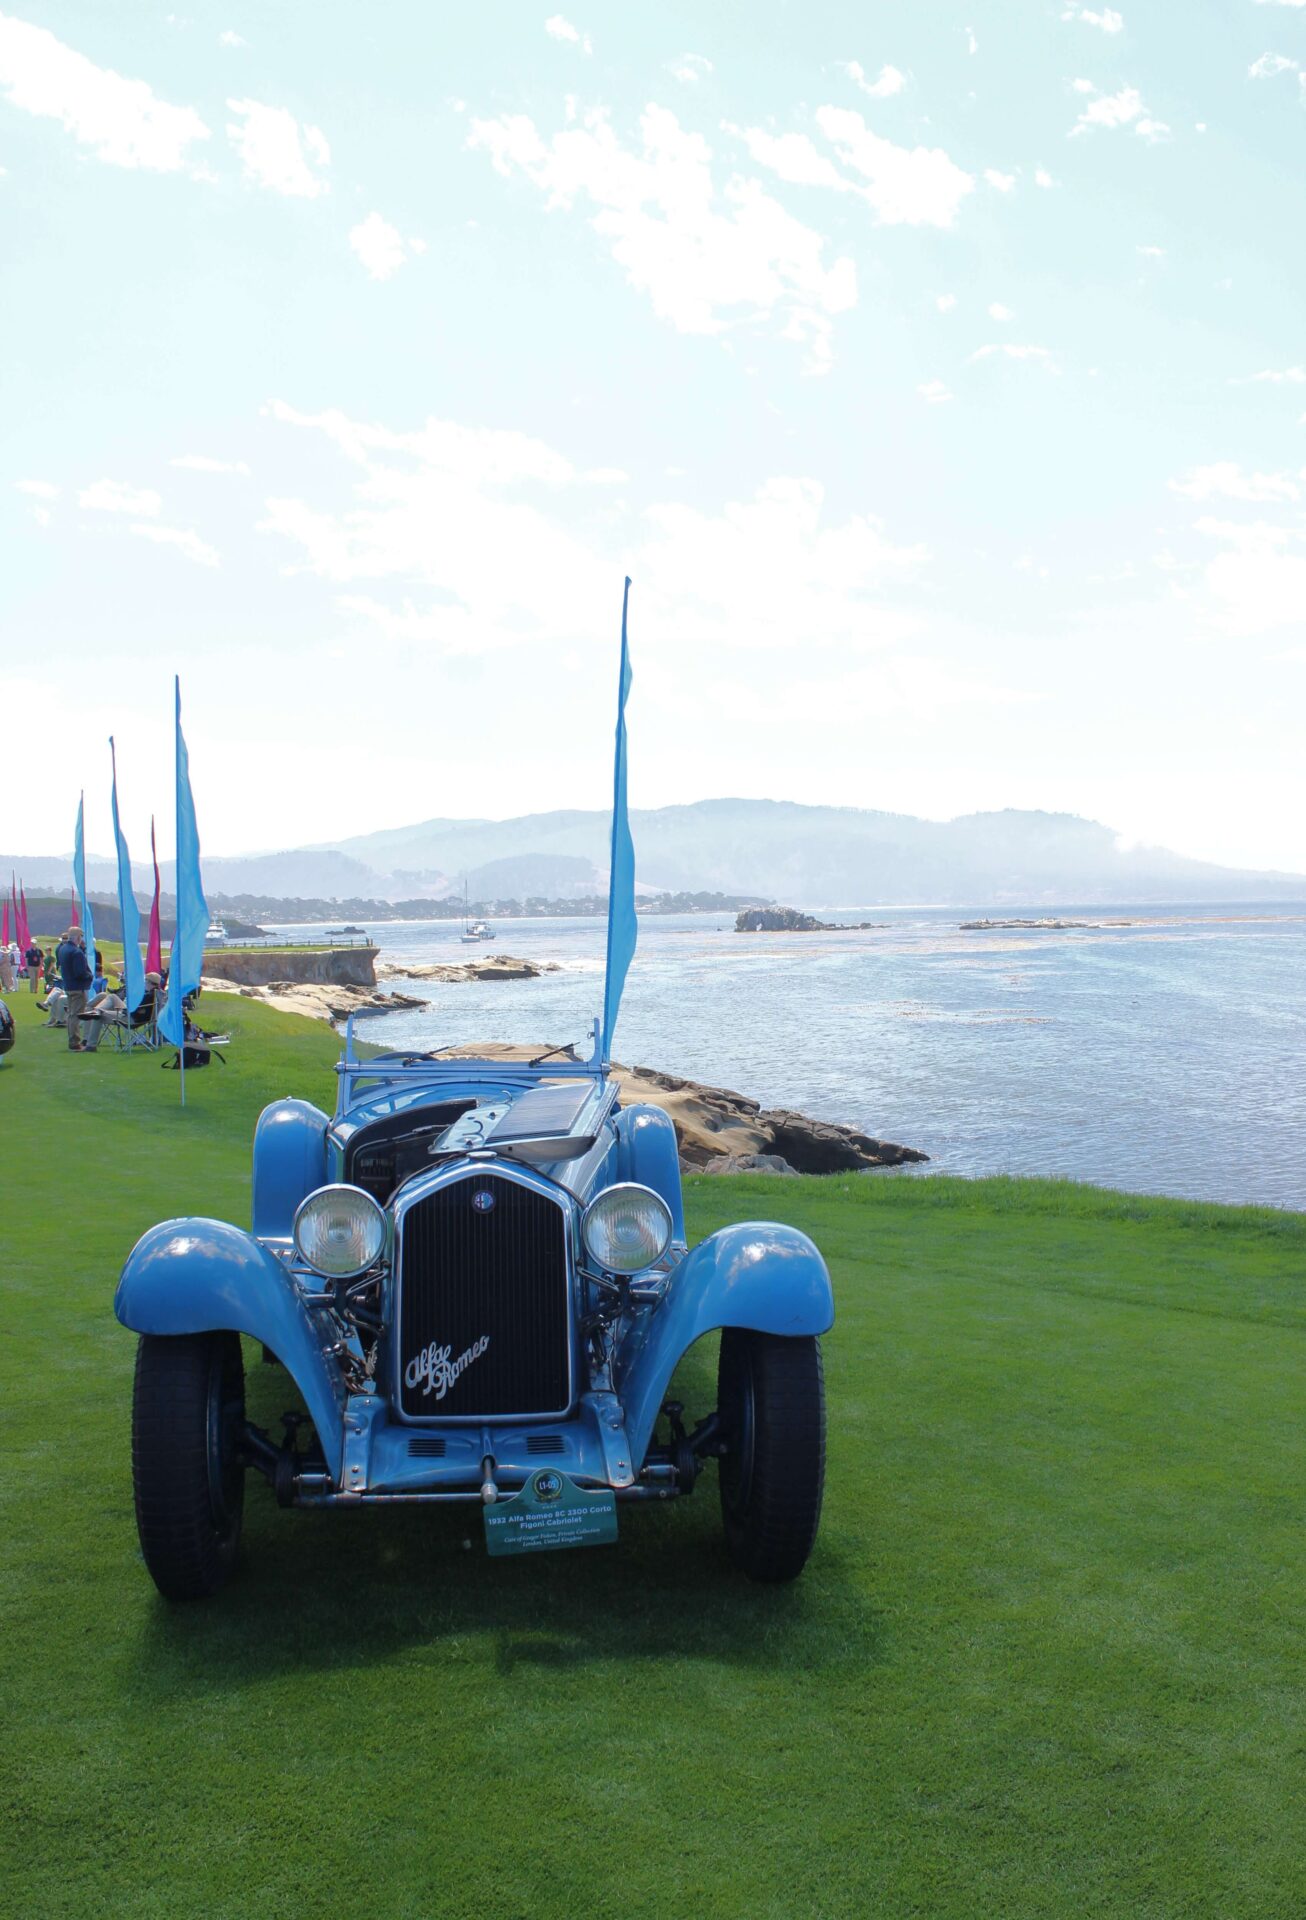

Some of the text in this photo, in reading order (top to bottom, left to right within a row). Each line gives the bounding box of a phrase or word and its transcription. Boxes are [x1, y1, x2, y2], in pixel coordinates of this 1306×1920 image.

[432, 1336, 490, 1401] Romeo
[488, 1516, 506, 1525] 1932
[508, 1515, 524, 1523] Alfa
[525, 1512, 553, 1521] Romeo
[589, 1505, 612, 1514] Corto
[520, 1516, 582, 1530] Figoni Cabriolet
